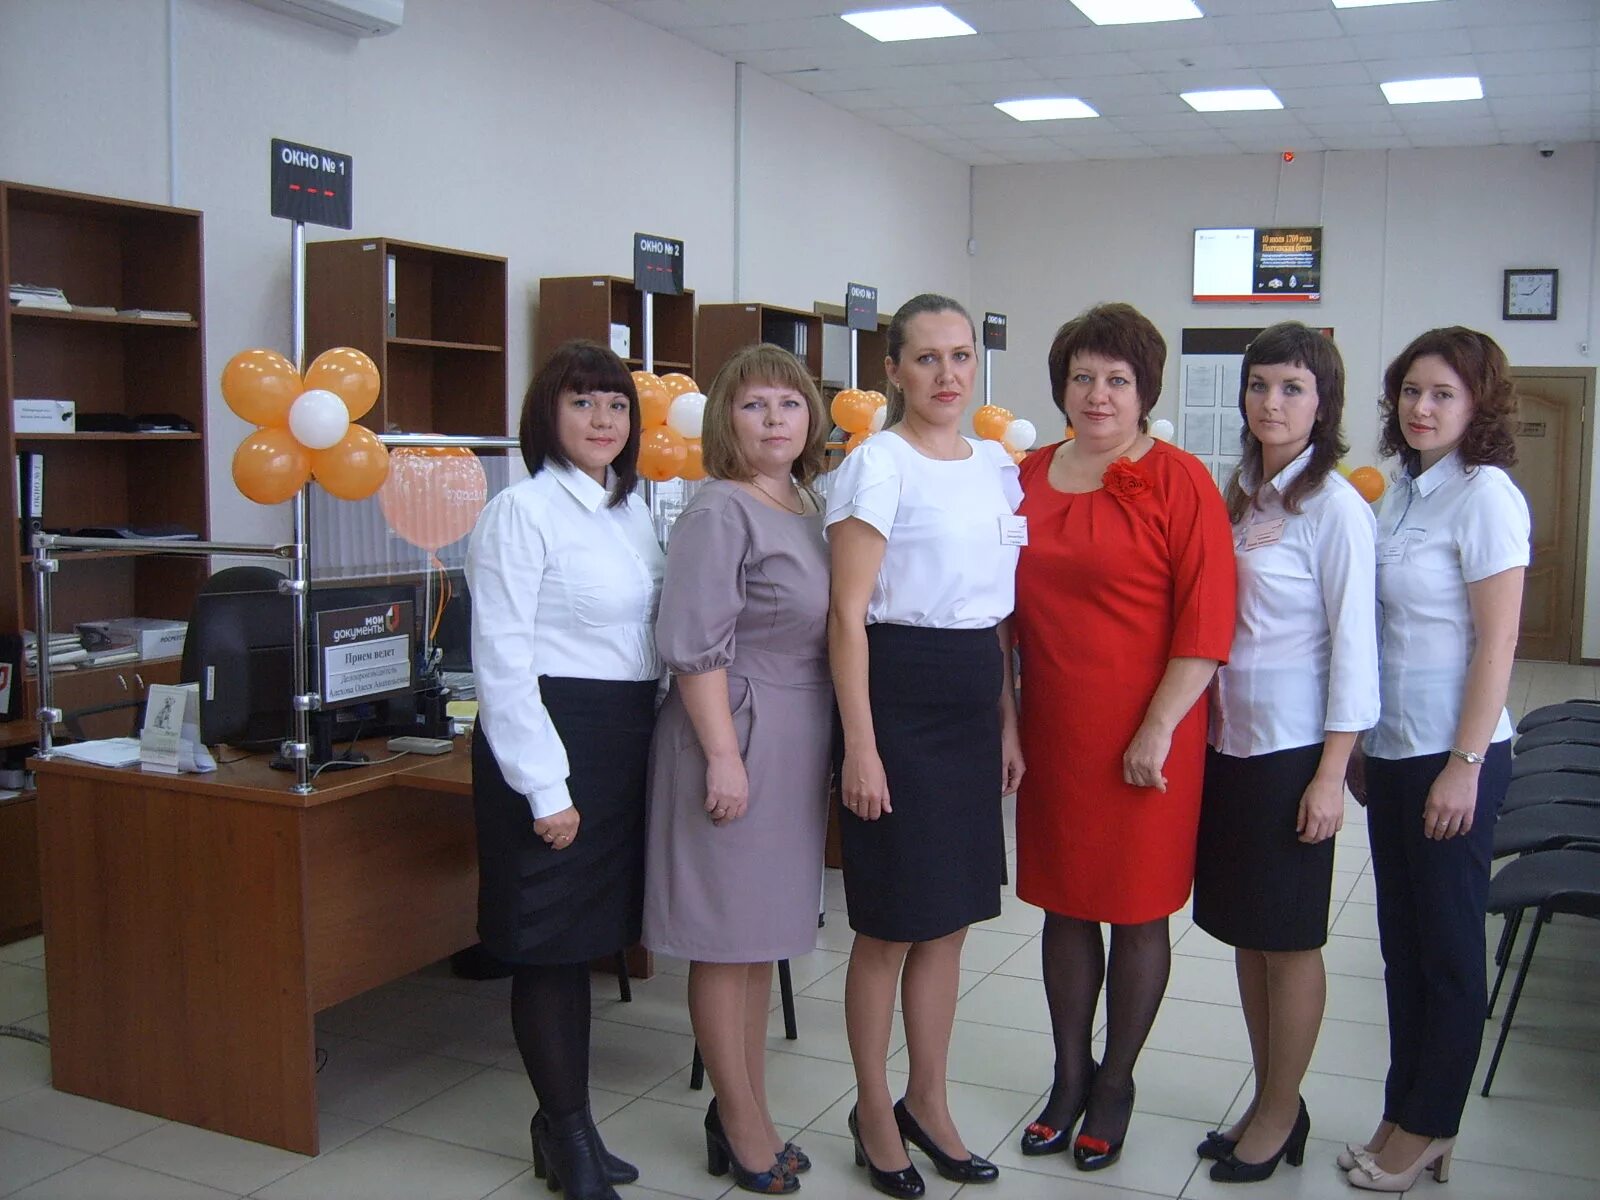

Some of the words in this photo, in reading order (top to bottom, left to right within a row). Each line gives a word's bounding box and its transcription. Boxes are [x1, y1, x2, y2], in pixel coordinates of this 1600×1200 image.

[281, 147, 319, 170] ОКНО
[322, 155, 336, 173] №
[339, 160, 345, 176] 1
[640, 239, 664, 254] ОКНО
[674, 244, 680, 257] 2
[333, 624, 385, 643] документы
[345, 651, 373, 665] Прием
[374, 648, 396, 659] ведет
